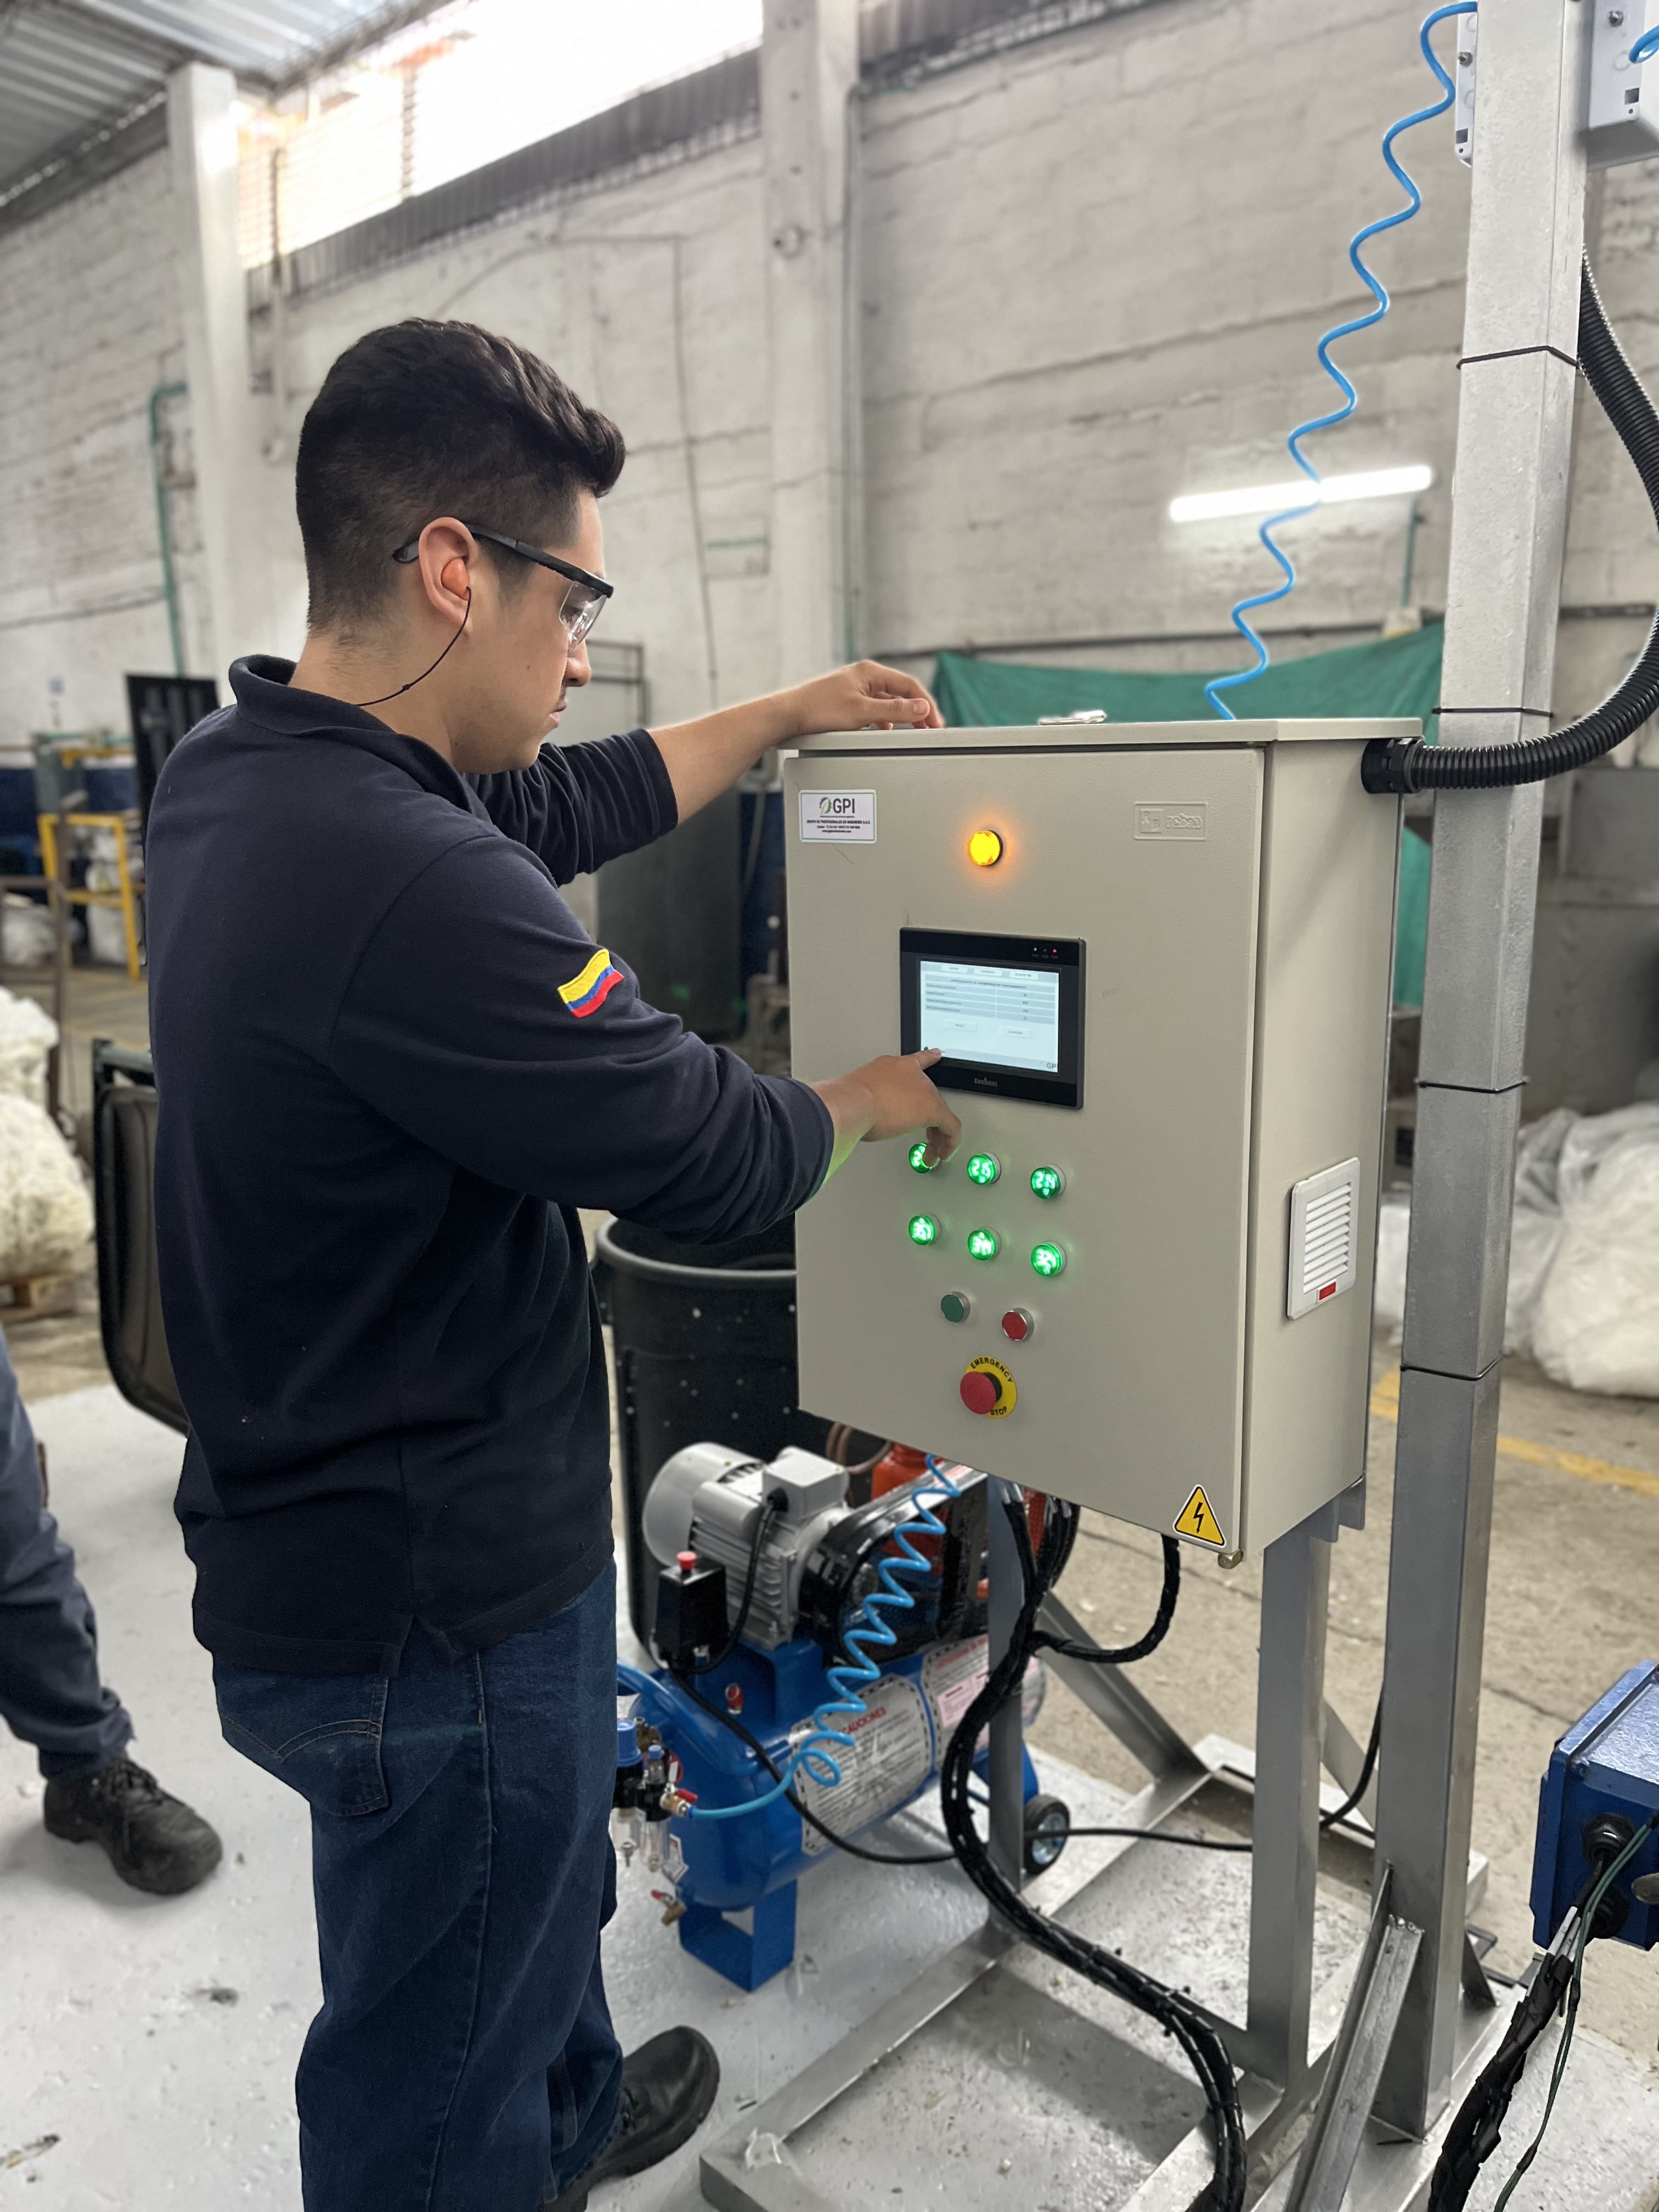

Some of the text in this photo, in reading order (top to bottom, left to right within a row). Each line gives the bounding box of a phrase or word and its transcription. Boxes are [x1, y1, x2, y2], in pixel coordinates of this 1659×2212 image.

[833, 798, 855, 814] GPI
[970, 1357, 1013, 1383] EMERGENCY
[990, 1406, 1007, 1416] STOP
